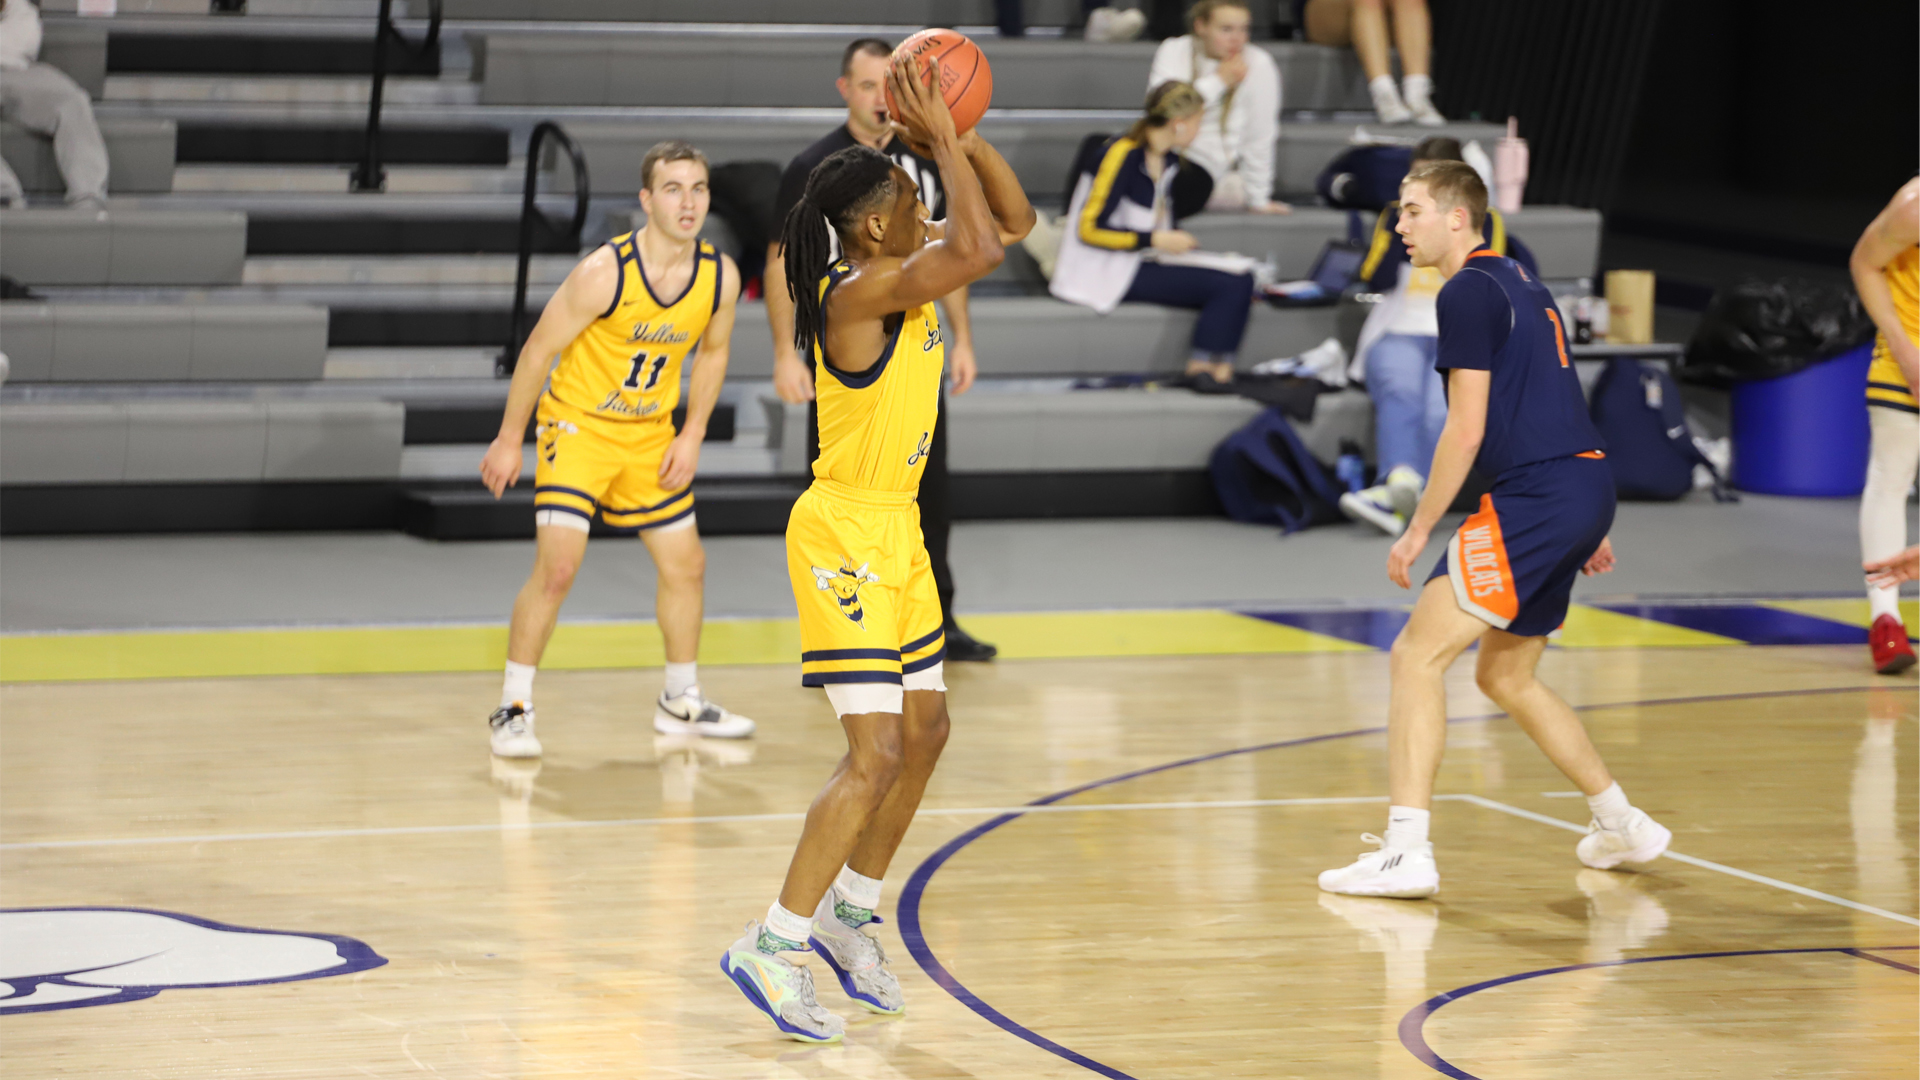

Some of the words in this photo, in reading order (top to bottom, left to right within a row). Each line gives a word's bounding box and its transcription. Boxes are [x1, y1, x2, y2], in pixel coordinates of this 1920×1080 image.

[626, 321, 689, 344] Yellow
[622, 350, 668, 391] 11
[1463, 524, 1505, 597] WILDCATS
